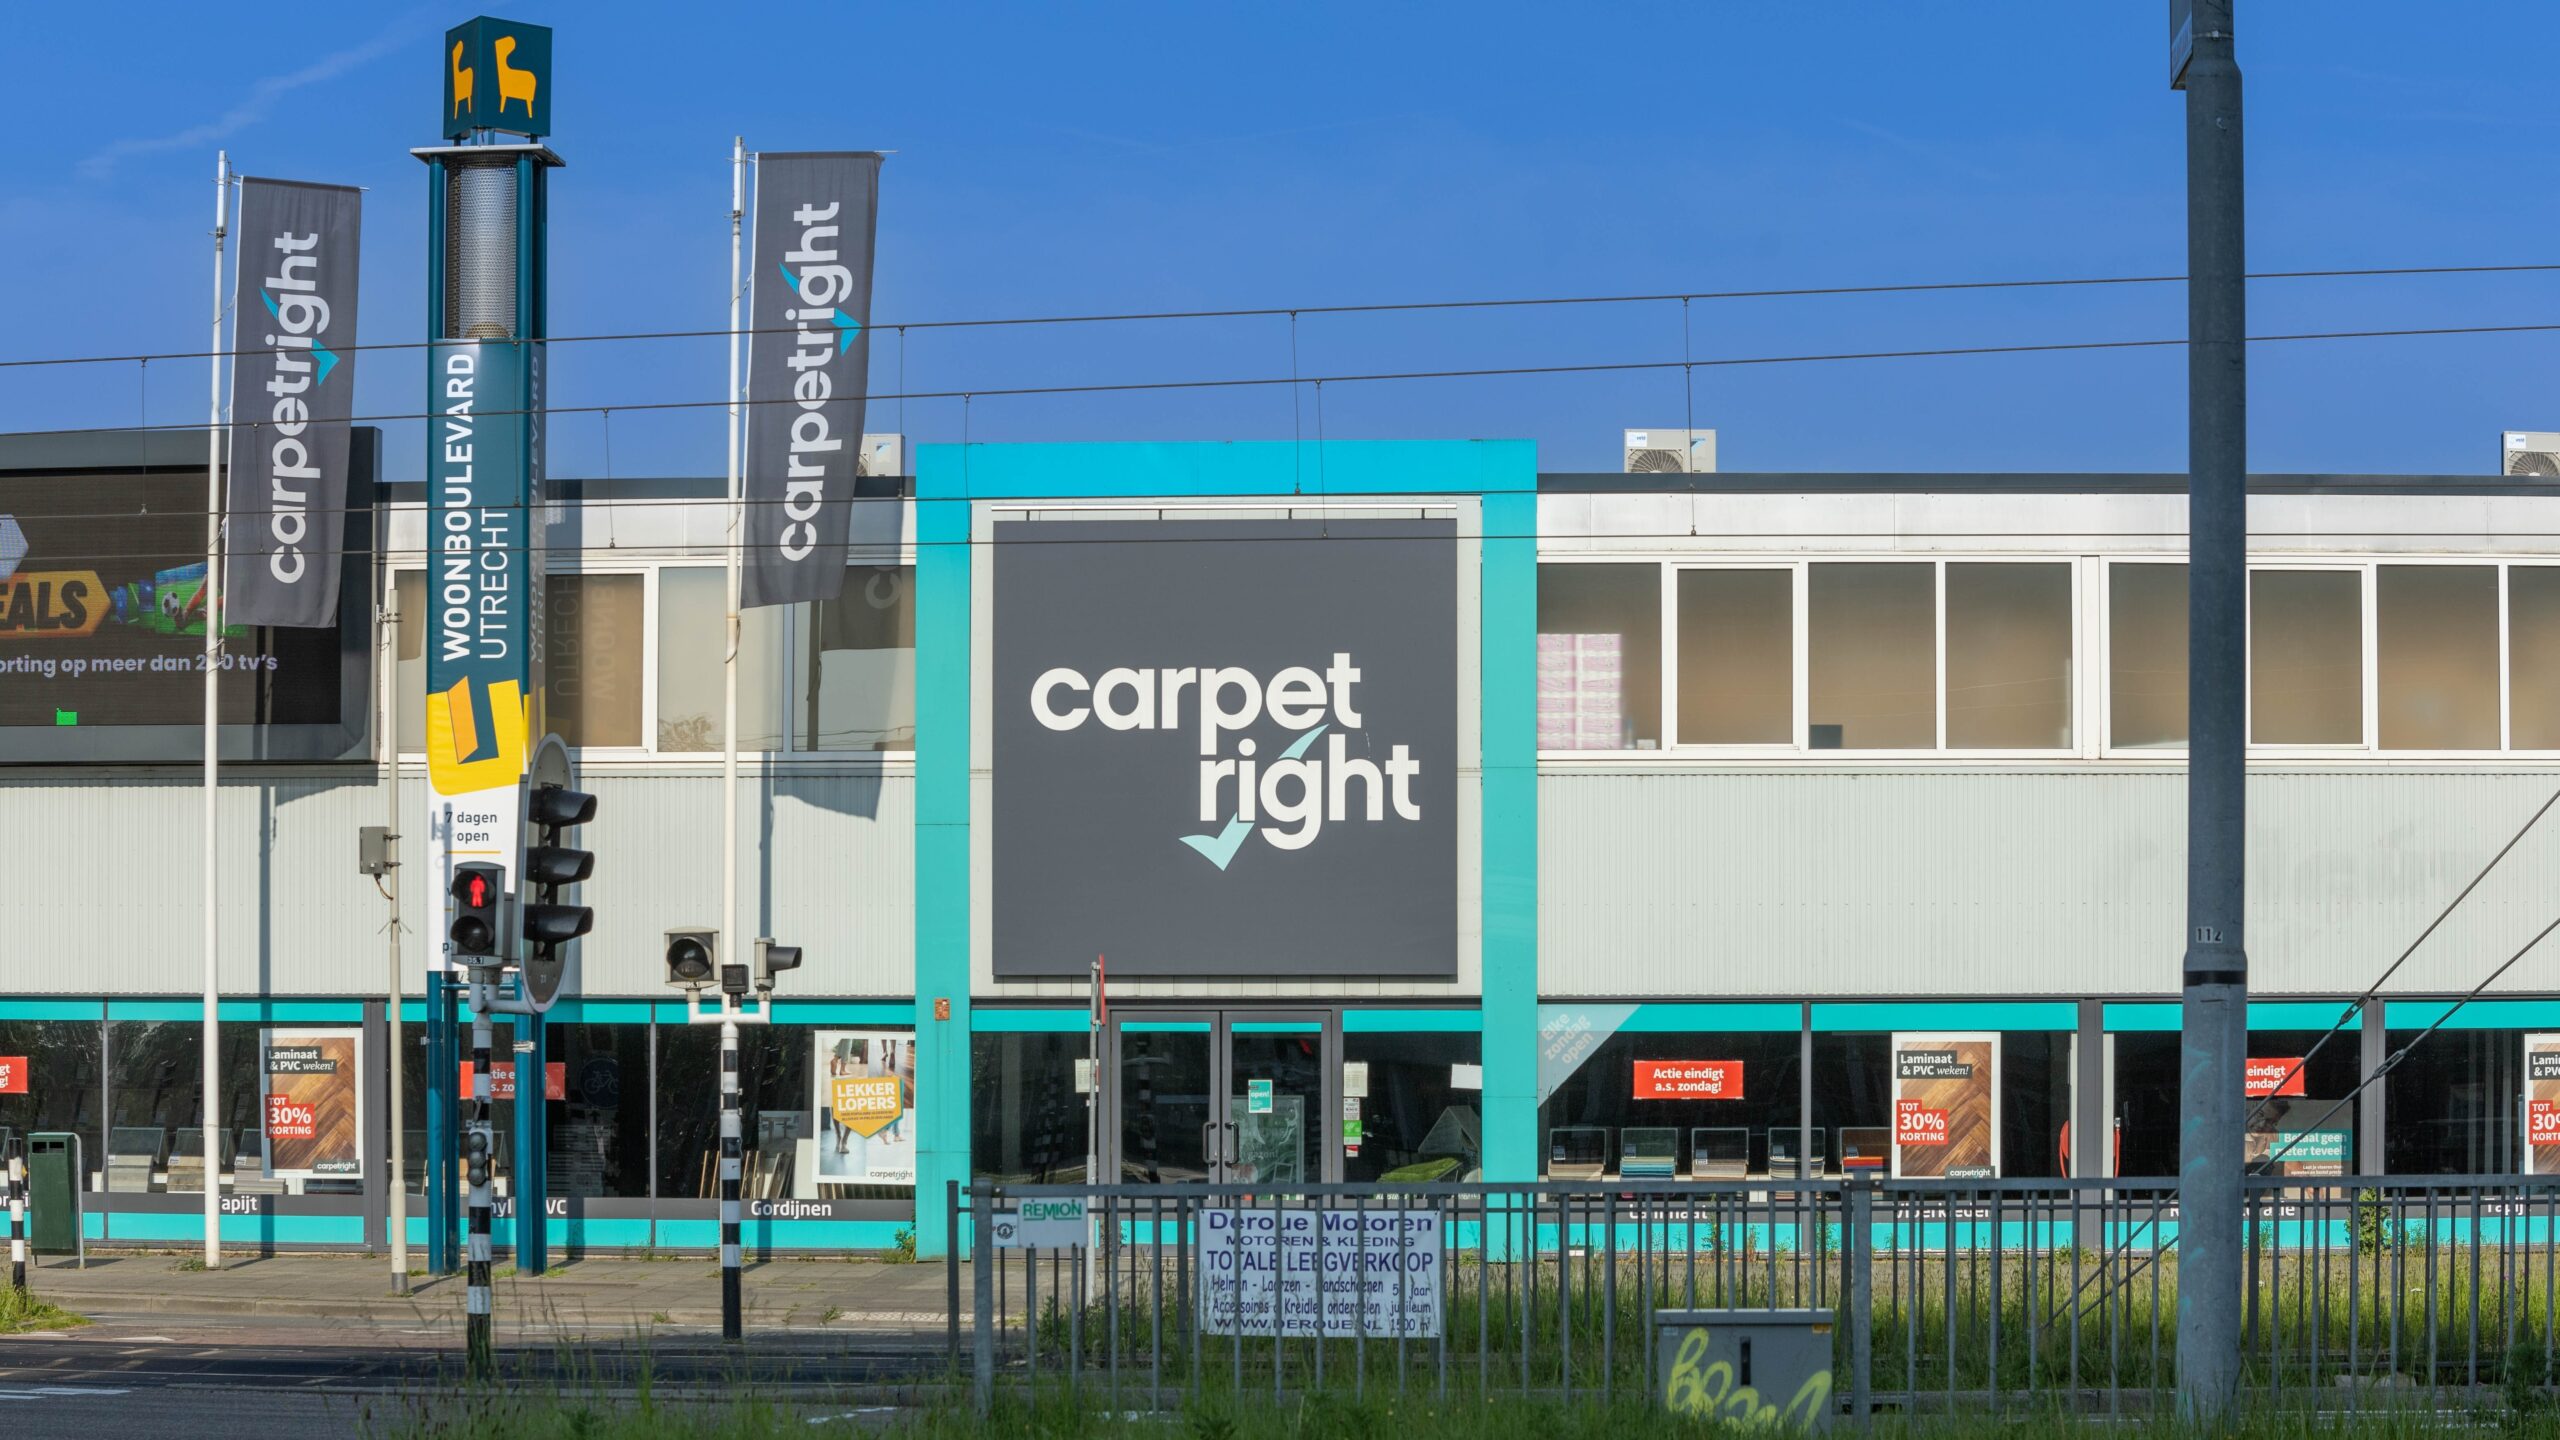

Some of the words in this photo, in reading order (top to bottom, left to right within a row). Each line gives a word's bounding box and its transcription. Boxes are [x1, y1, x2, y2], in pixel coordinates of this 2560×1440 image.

[780, 201, 853, 562] carpetright
[266, 232, 330, 584] carpetright
[443, 354, 474, 661] WOONBOULEVARD
[480, 506, 508, 659] UTRECHT
[61, 658, 87, 677] op
[91, 658, 146, 672] meer
[150, 655, 190, 671] dan
[195, 654, 234, 670] 20
[1030, 652, 1362, 755] carpet
[1199, 734, 1420, 850] right
[445, 812, 453, 823] 7
[457, 812, 497, 825] dagen
[457, 832, 489, 844] open
[1541, 1014, 1570, 1040] Elke
[1544, 1014, 1591, 1060] zondag
[268, 1049, 317, 1060] Laminaat
[1562, 1032, 1593, 1064] open
[1900, 1053, 1953, 1064] Laminaat
[2532, 1055, 2560, 1065] Lami
[280, 1061, 302, 1071] PVC
[302, 1061, 334, 1071] weken!
[1902, 1065, 1911, 1075] &
[1913, 1065, 1935, 1075] PVC
[1936, 1065, 1969, 1075] weken!
[2247, 1065, 2286, 1079] eindigt
[2534, 1067, 2542, 1076] &
[2545, 1067, 2560, 1076] PV
[1653, 1068, 1682, 1079] Actie
[1684, 1068, 1724, 1081] eindigt
[837, 1082, 895, 1097] LEKKER
[1655, 1083, 1675, 1092] a.s.
[1677, 1081, 1722, 1093] zondag!
[268, 1097, 286, 1106] TOT
[838, 1097, 897, 1112] LOPERS
[1900, 1103, 1919, 1111] TOT
[2532, 1104, 2550, 1112] TOT
[269, 1107, 312, 1124] 30%
[1900, 1113, 1945, 1131] 30%
[269, 1126, 312, 1135] KORTING
[1900, 1132, 1945, 1141] KORTING
[2320, 1134, 2347, 1145] geen
[317, 1162, 356, 1171] carpetright
[870, 1170, 913, 1180] carpetright
[1949, 1169, 1991, 1178] carpetright
[218, 1195, 258, 1214] apijt
[546, 1199, 567, 1215] VC
[751, 1200, 832, 1219] Gordijnen
[1023, 1203, 1082, 1218] REMION
[1322, 1213, 1432, 1231] Motoren
[1226, 1235, 1314, 1246] MOTOREN
[1337, 1236, 1415, 1247] KLEDING
